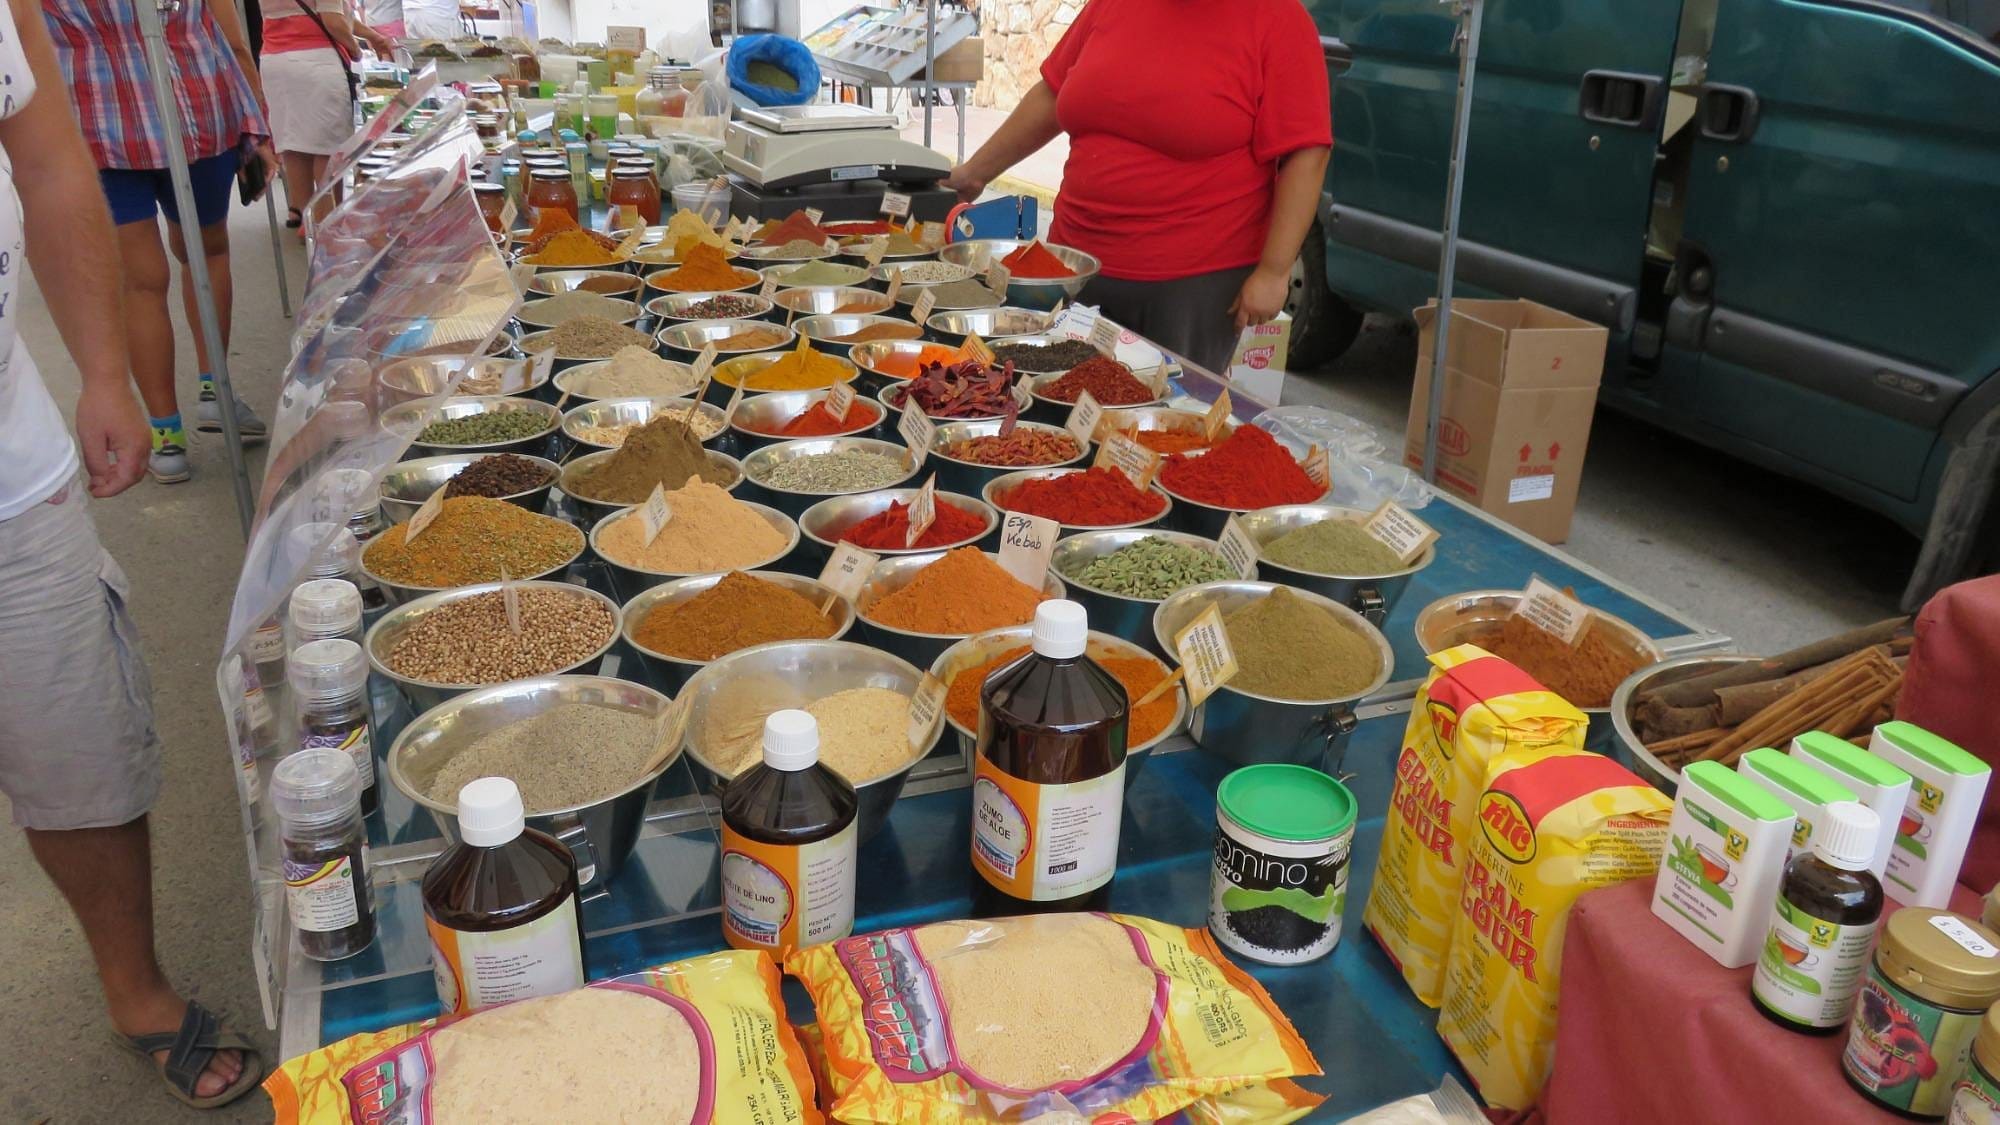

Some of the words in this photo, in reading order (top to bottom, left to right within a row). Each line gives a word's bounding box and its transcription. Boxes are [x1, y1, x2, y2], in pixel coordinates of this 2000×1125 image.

[1007, 516, 1033, 533] Esp.
[1006, 533, 1042, 550] Kebab
[981, 800, 1003, 823] ZUMO
[979, 810, 989, 824] DE
[989, 821, 1012, 840] ALOE
[1481, 799, 1531, 853] KTC
[1675, 860, 1701, 884] STEVIA
[743, 890, 754, 900] DE
[755, 892, 775, 904] LINO
[808, 927, 822, 937] 500
